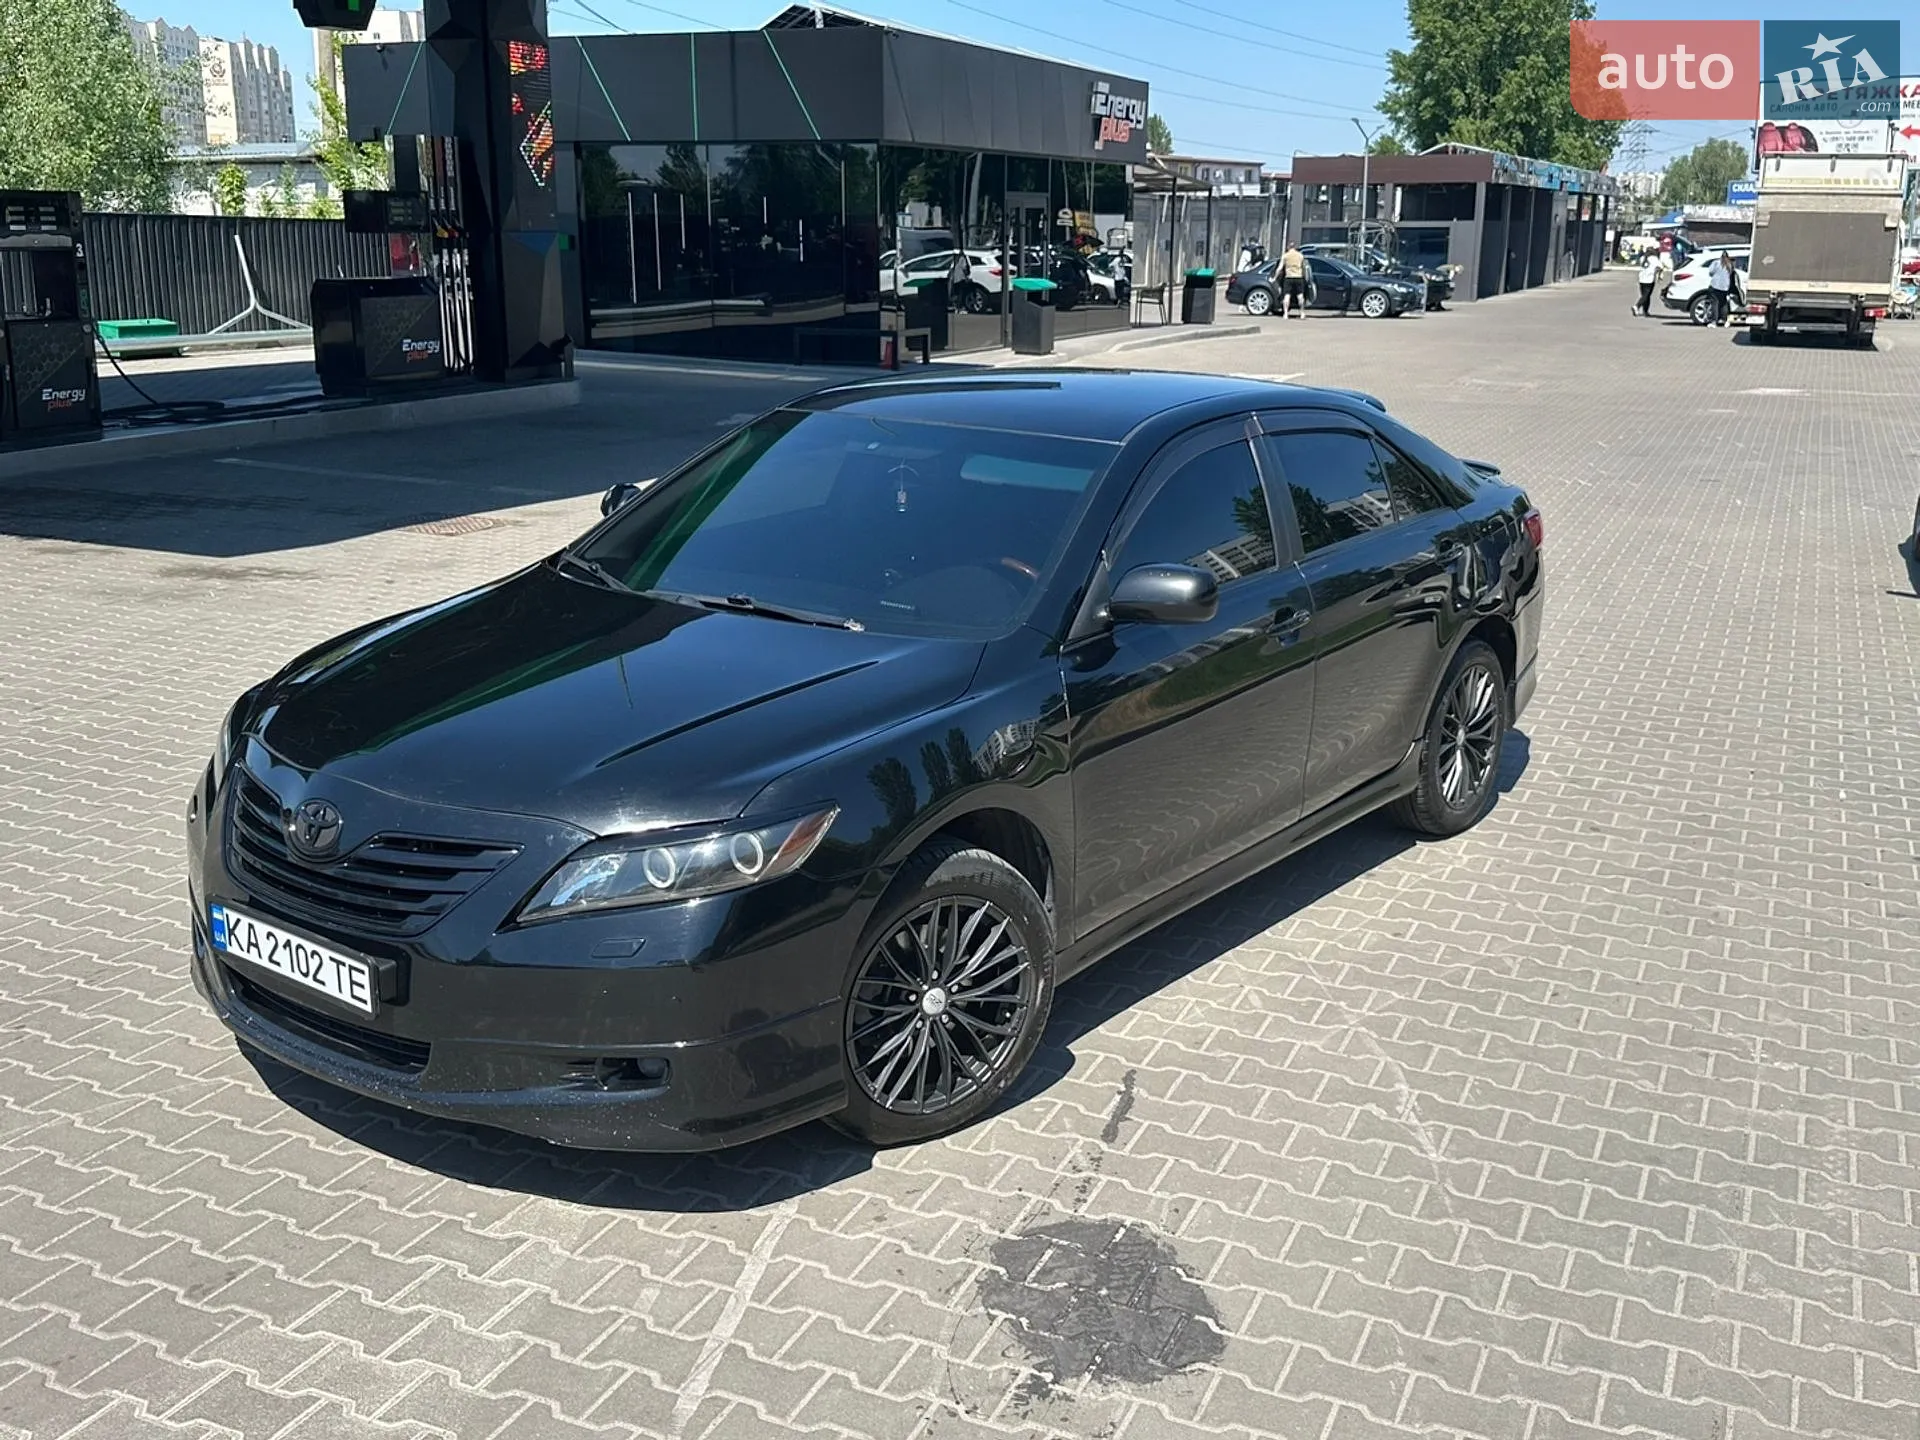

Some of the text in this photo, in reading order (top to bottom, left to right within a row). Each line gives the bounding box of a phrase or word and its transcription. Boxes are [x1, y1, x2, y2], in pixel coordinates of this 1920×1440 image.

[1091, 81, 1147, 130] Energy
[1813, 102, 1838, 112] АВТО
[1094, 116, 1130, 150] plus
[75, 242, 84, 258] 3
[402, 339, 440, 354] Energy
[42, 388, 86, 403] Energy
[214, 931, 227, 944] UA
